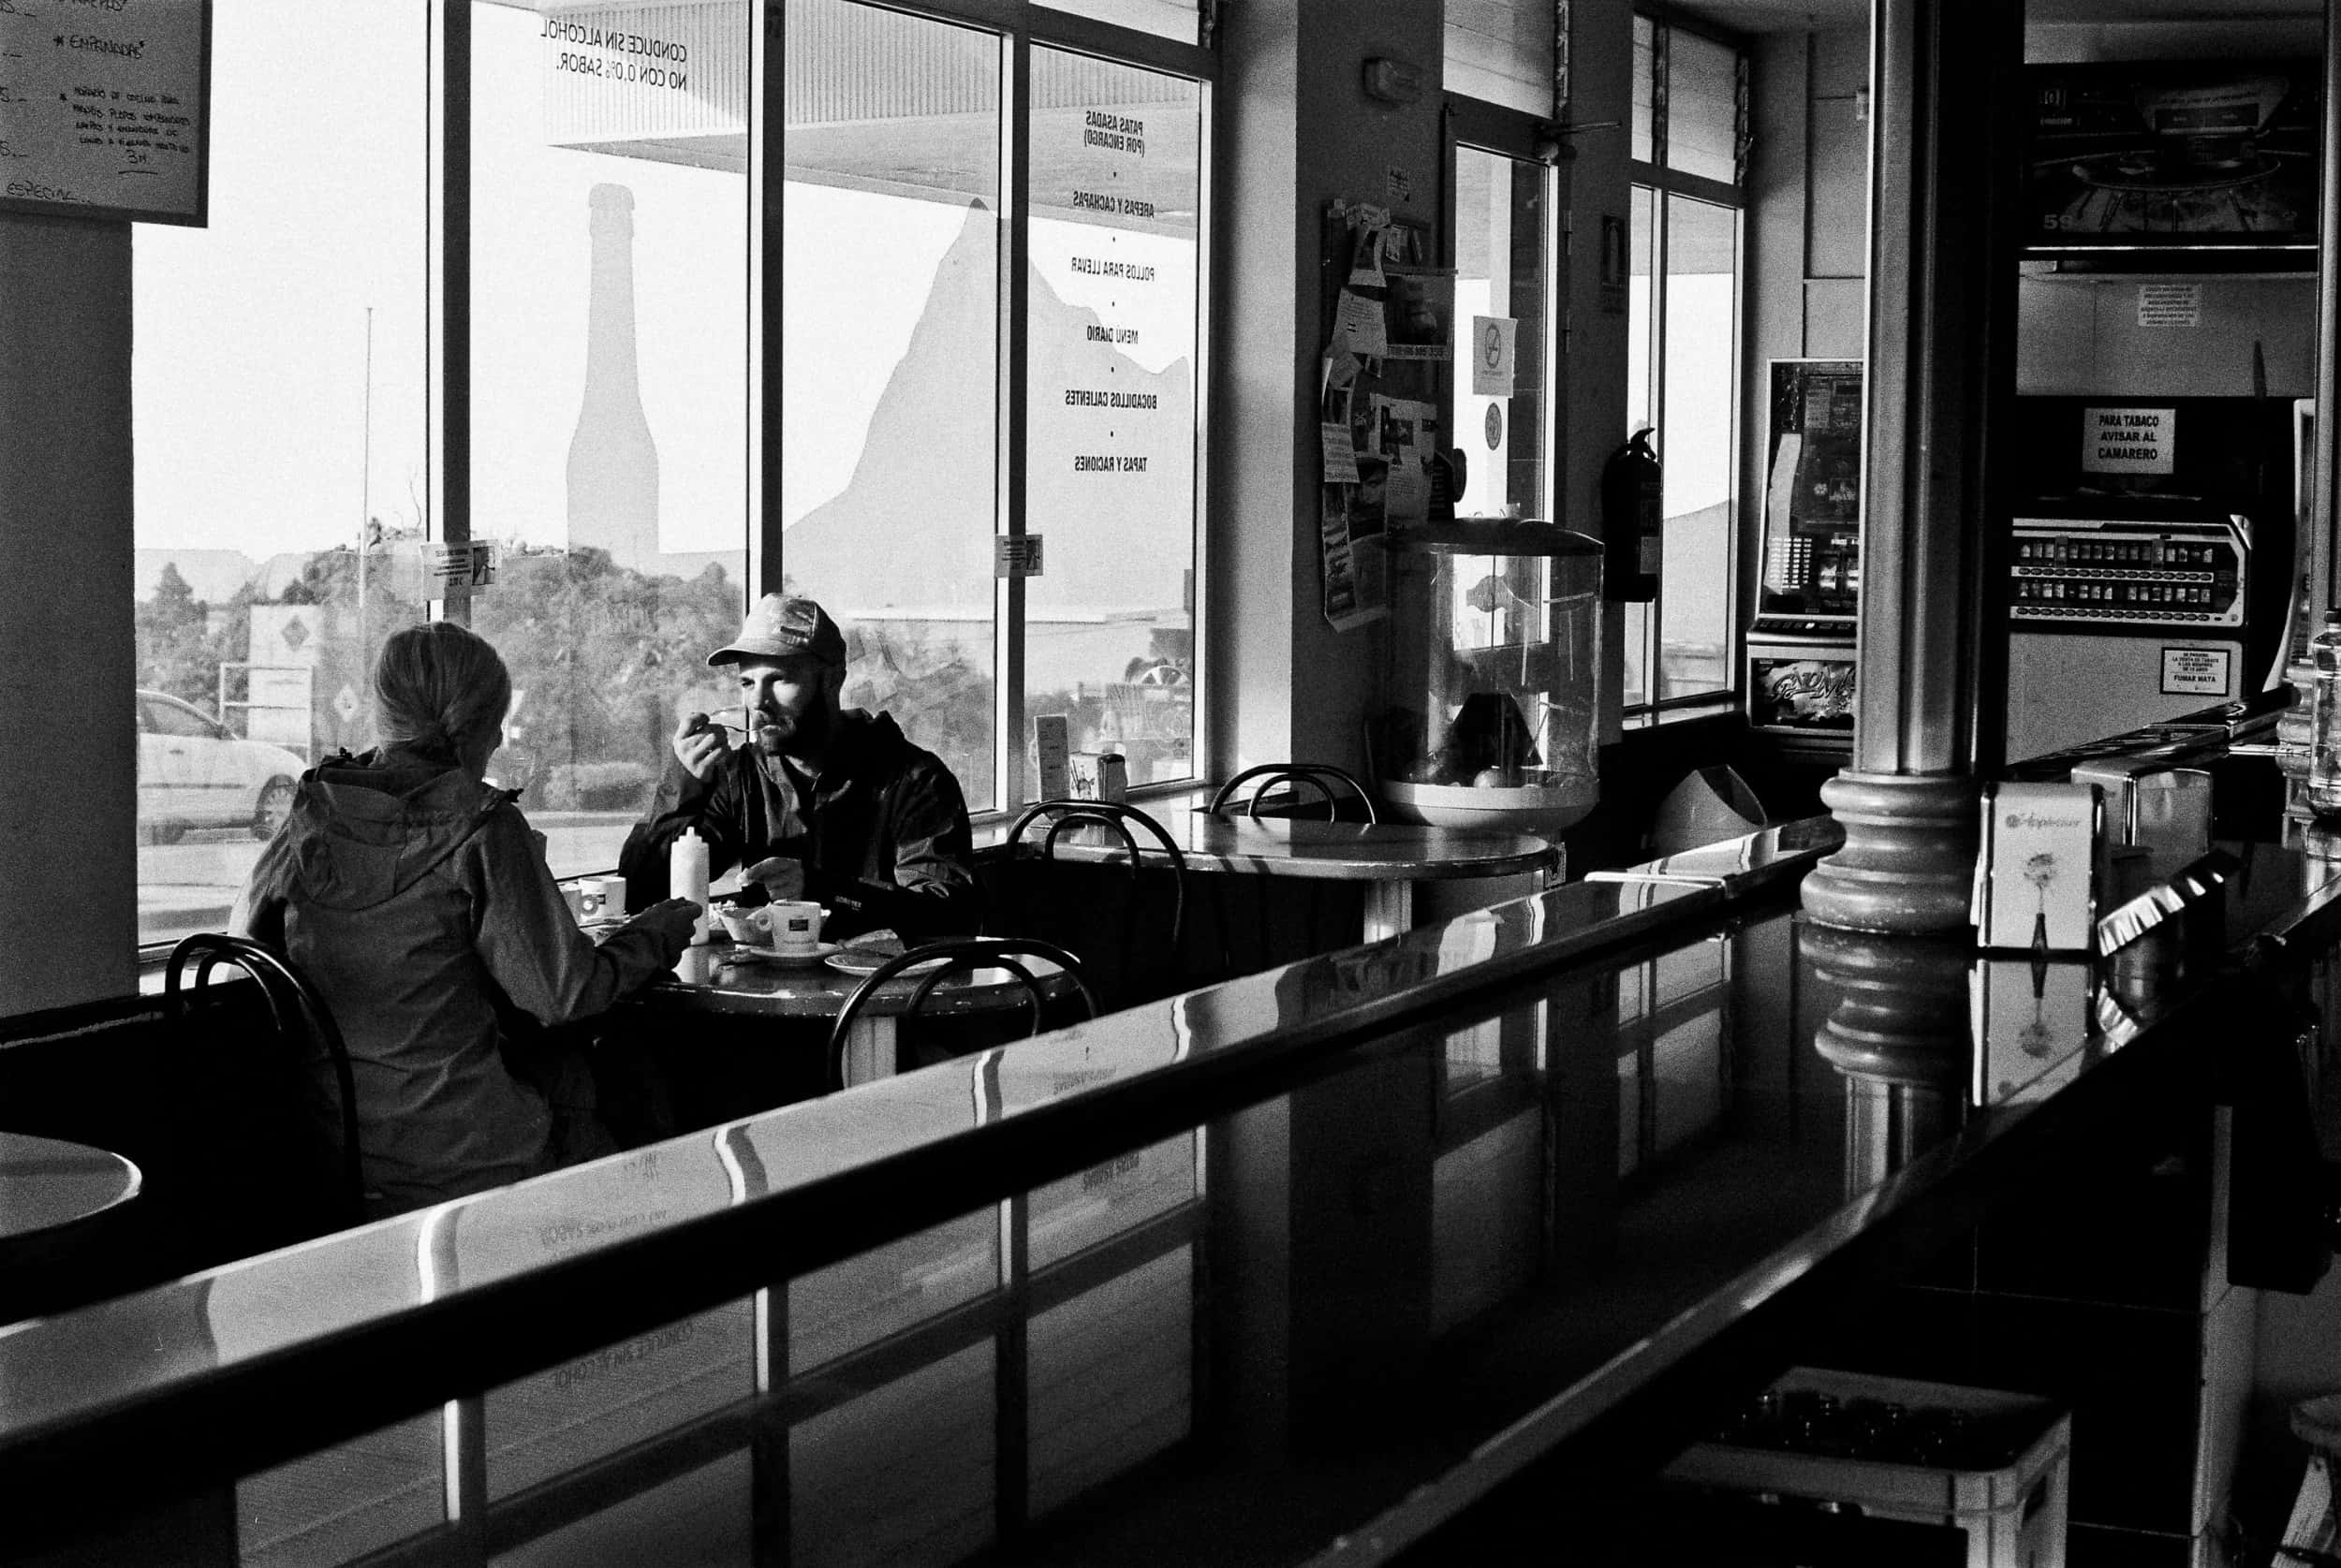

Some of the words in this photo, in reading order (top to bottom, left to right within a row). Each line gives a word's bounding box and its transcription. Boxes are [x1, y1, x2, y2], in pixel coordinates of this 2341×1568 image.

[2098, 415, 2122, 427] PARA
[2123, 415, 2159, 428] TABACO
[2100, 431, 2140, 442] AVISAR
[2142, 432, 2157, 443] AL
[2098, 447, 2157, 461] CAMARERO
